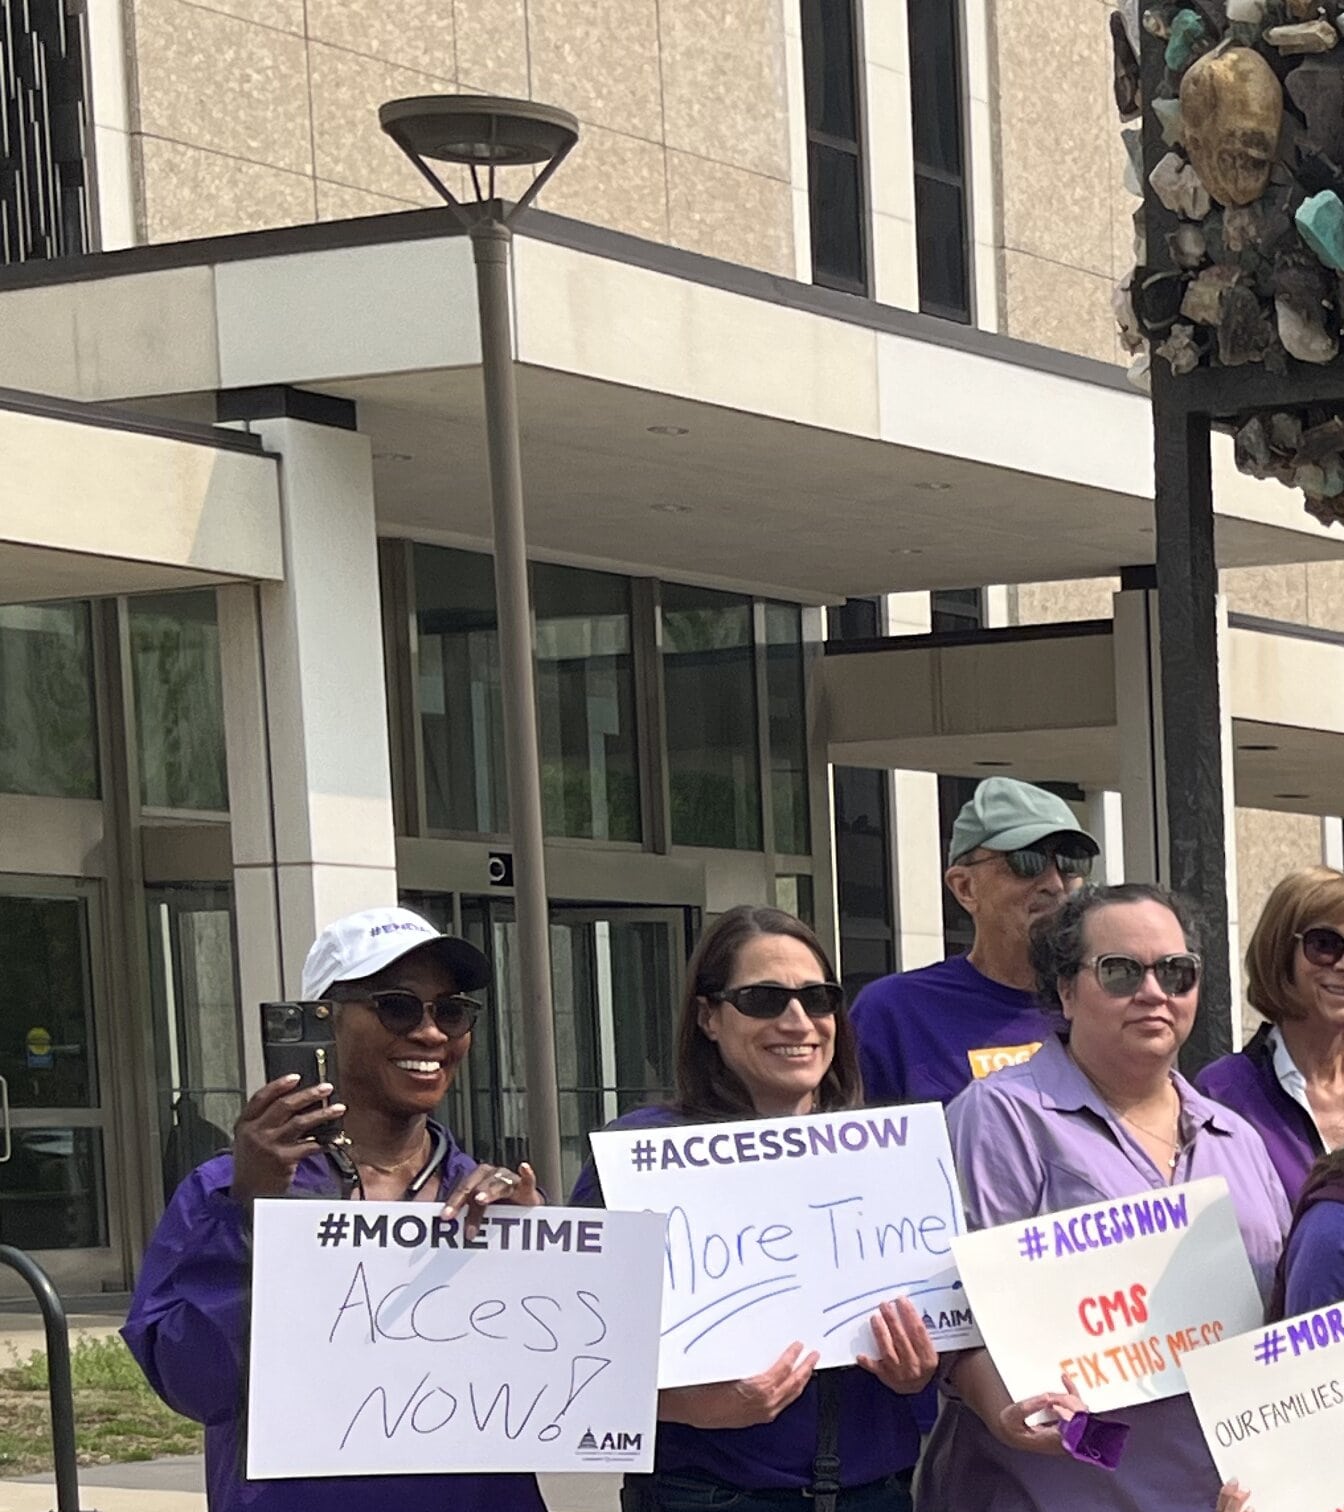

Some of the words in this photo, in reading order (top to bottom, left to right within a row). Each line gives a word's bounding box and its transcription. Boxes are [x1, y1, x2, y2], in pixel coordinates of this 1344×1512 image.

[631, 1116, 909, 1172] #ACCESSNOW
[317, 1213, 604, 1254] #MORETIME
[1017, 1193, 1190, 1261] #ACCESSNOW
[938, 1308, 973, 1329] AIM
[1077, 1283, 1149, 1337] CMS
[1059, 1352, 1110, 1390] FIX
[1103, 1336, 1166, 1382] THIS
[600, 1431, 643, 1451] AIM
[1214, 1409, 1262, 1449] OUR
[1258, 1379, 1344, 1433] FAMILIES
